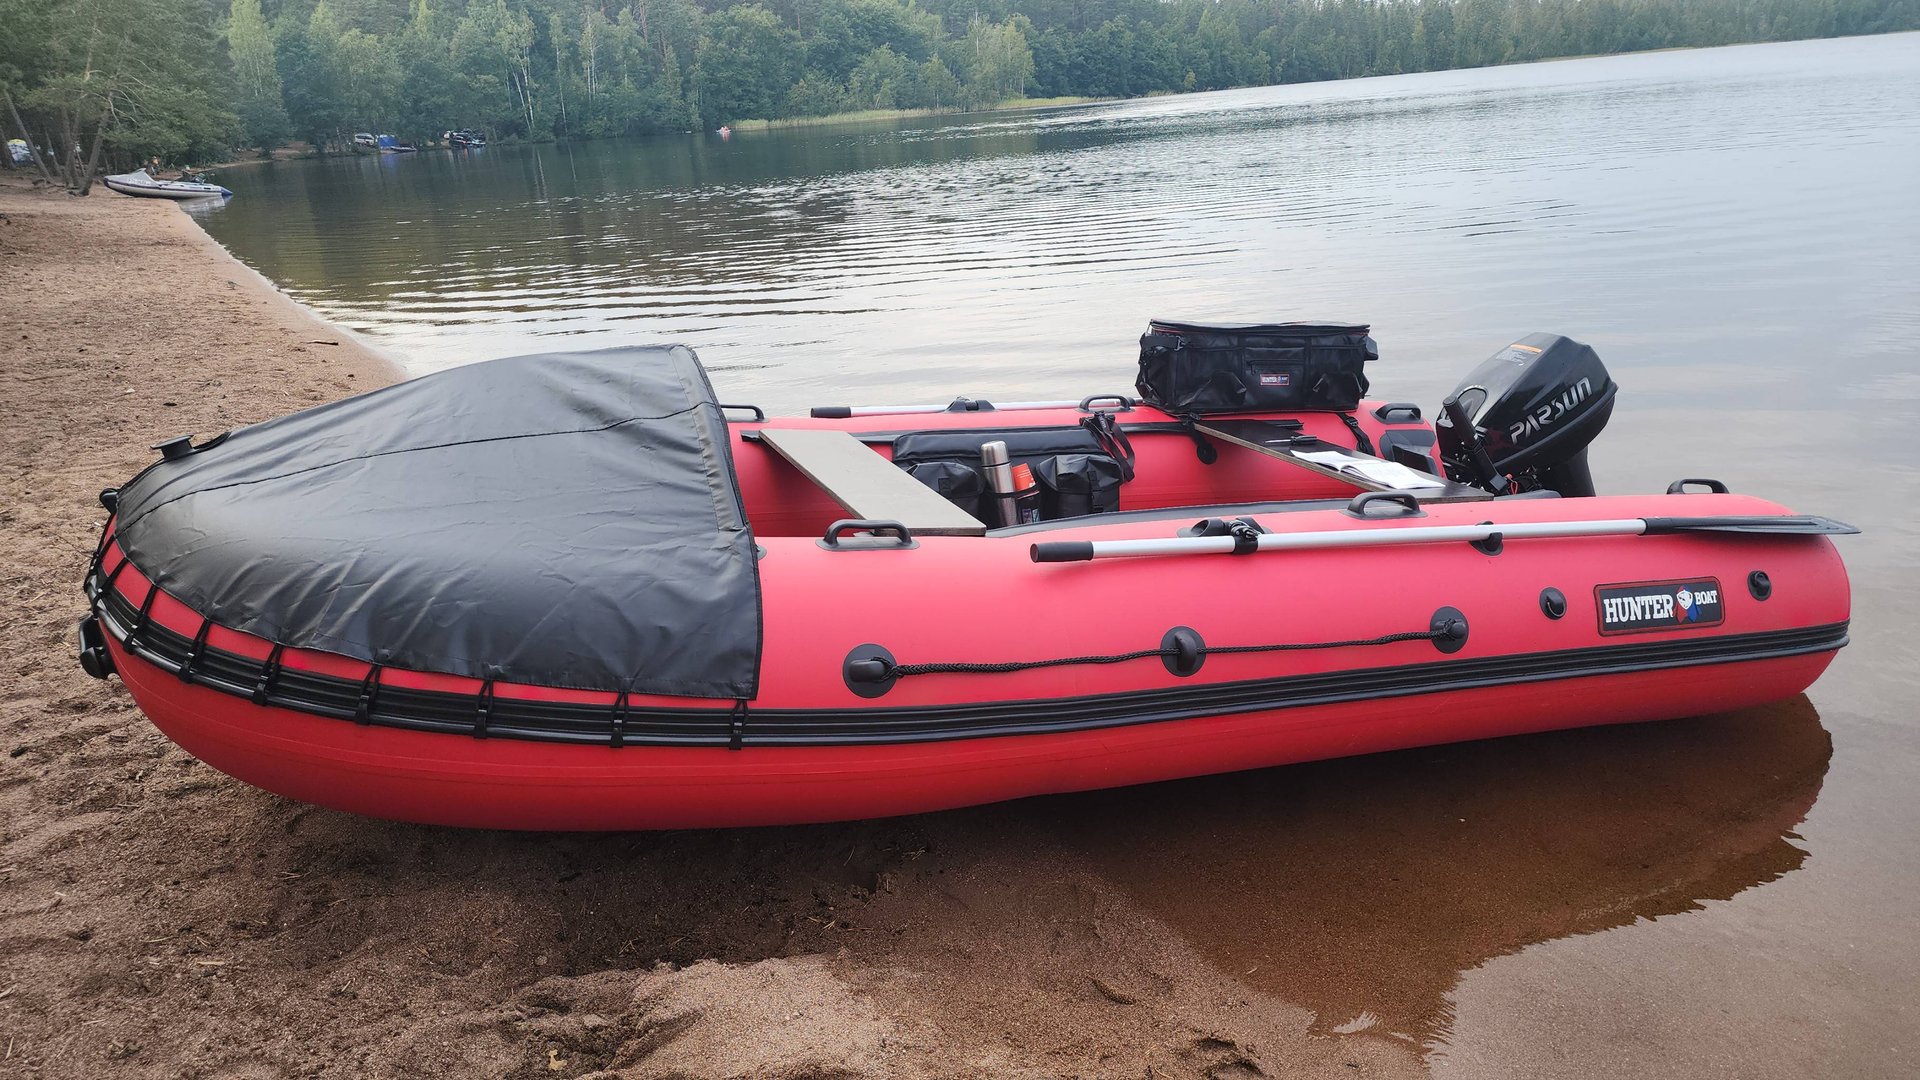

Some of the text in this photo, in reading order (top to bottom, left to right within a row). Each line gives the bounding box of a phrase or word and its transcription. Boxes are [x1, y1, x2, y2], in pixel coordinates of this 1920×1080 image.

[1510, 377, 1593, 445] PARSUN
[1603, 590, 1718, 623] HUNTER BOAT
